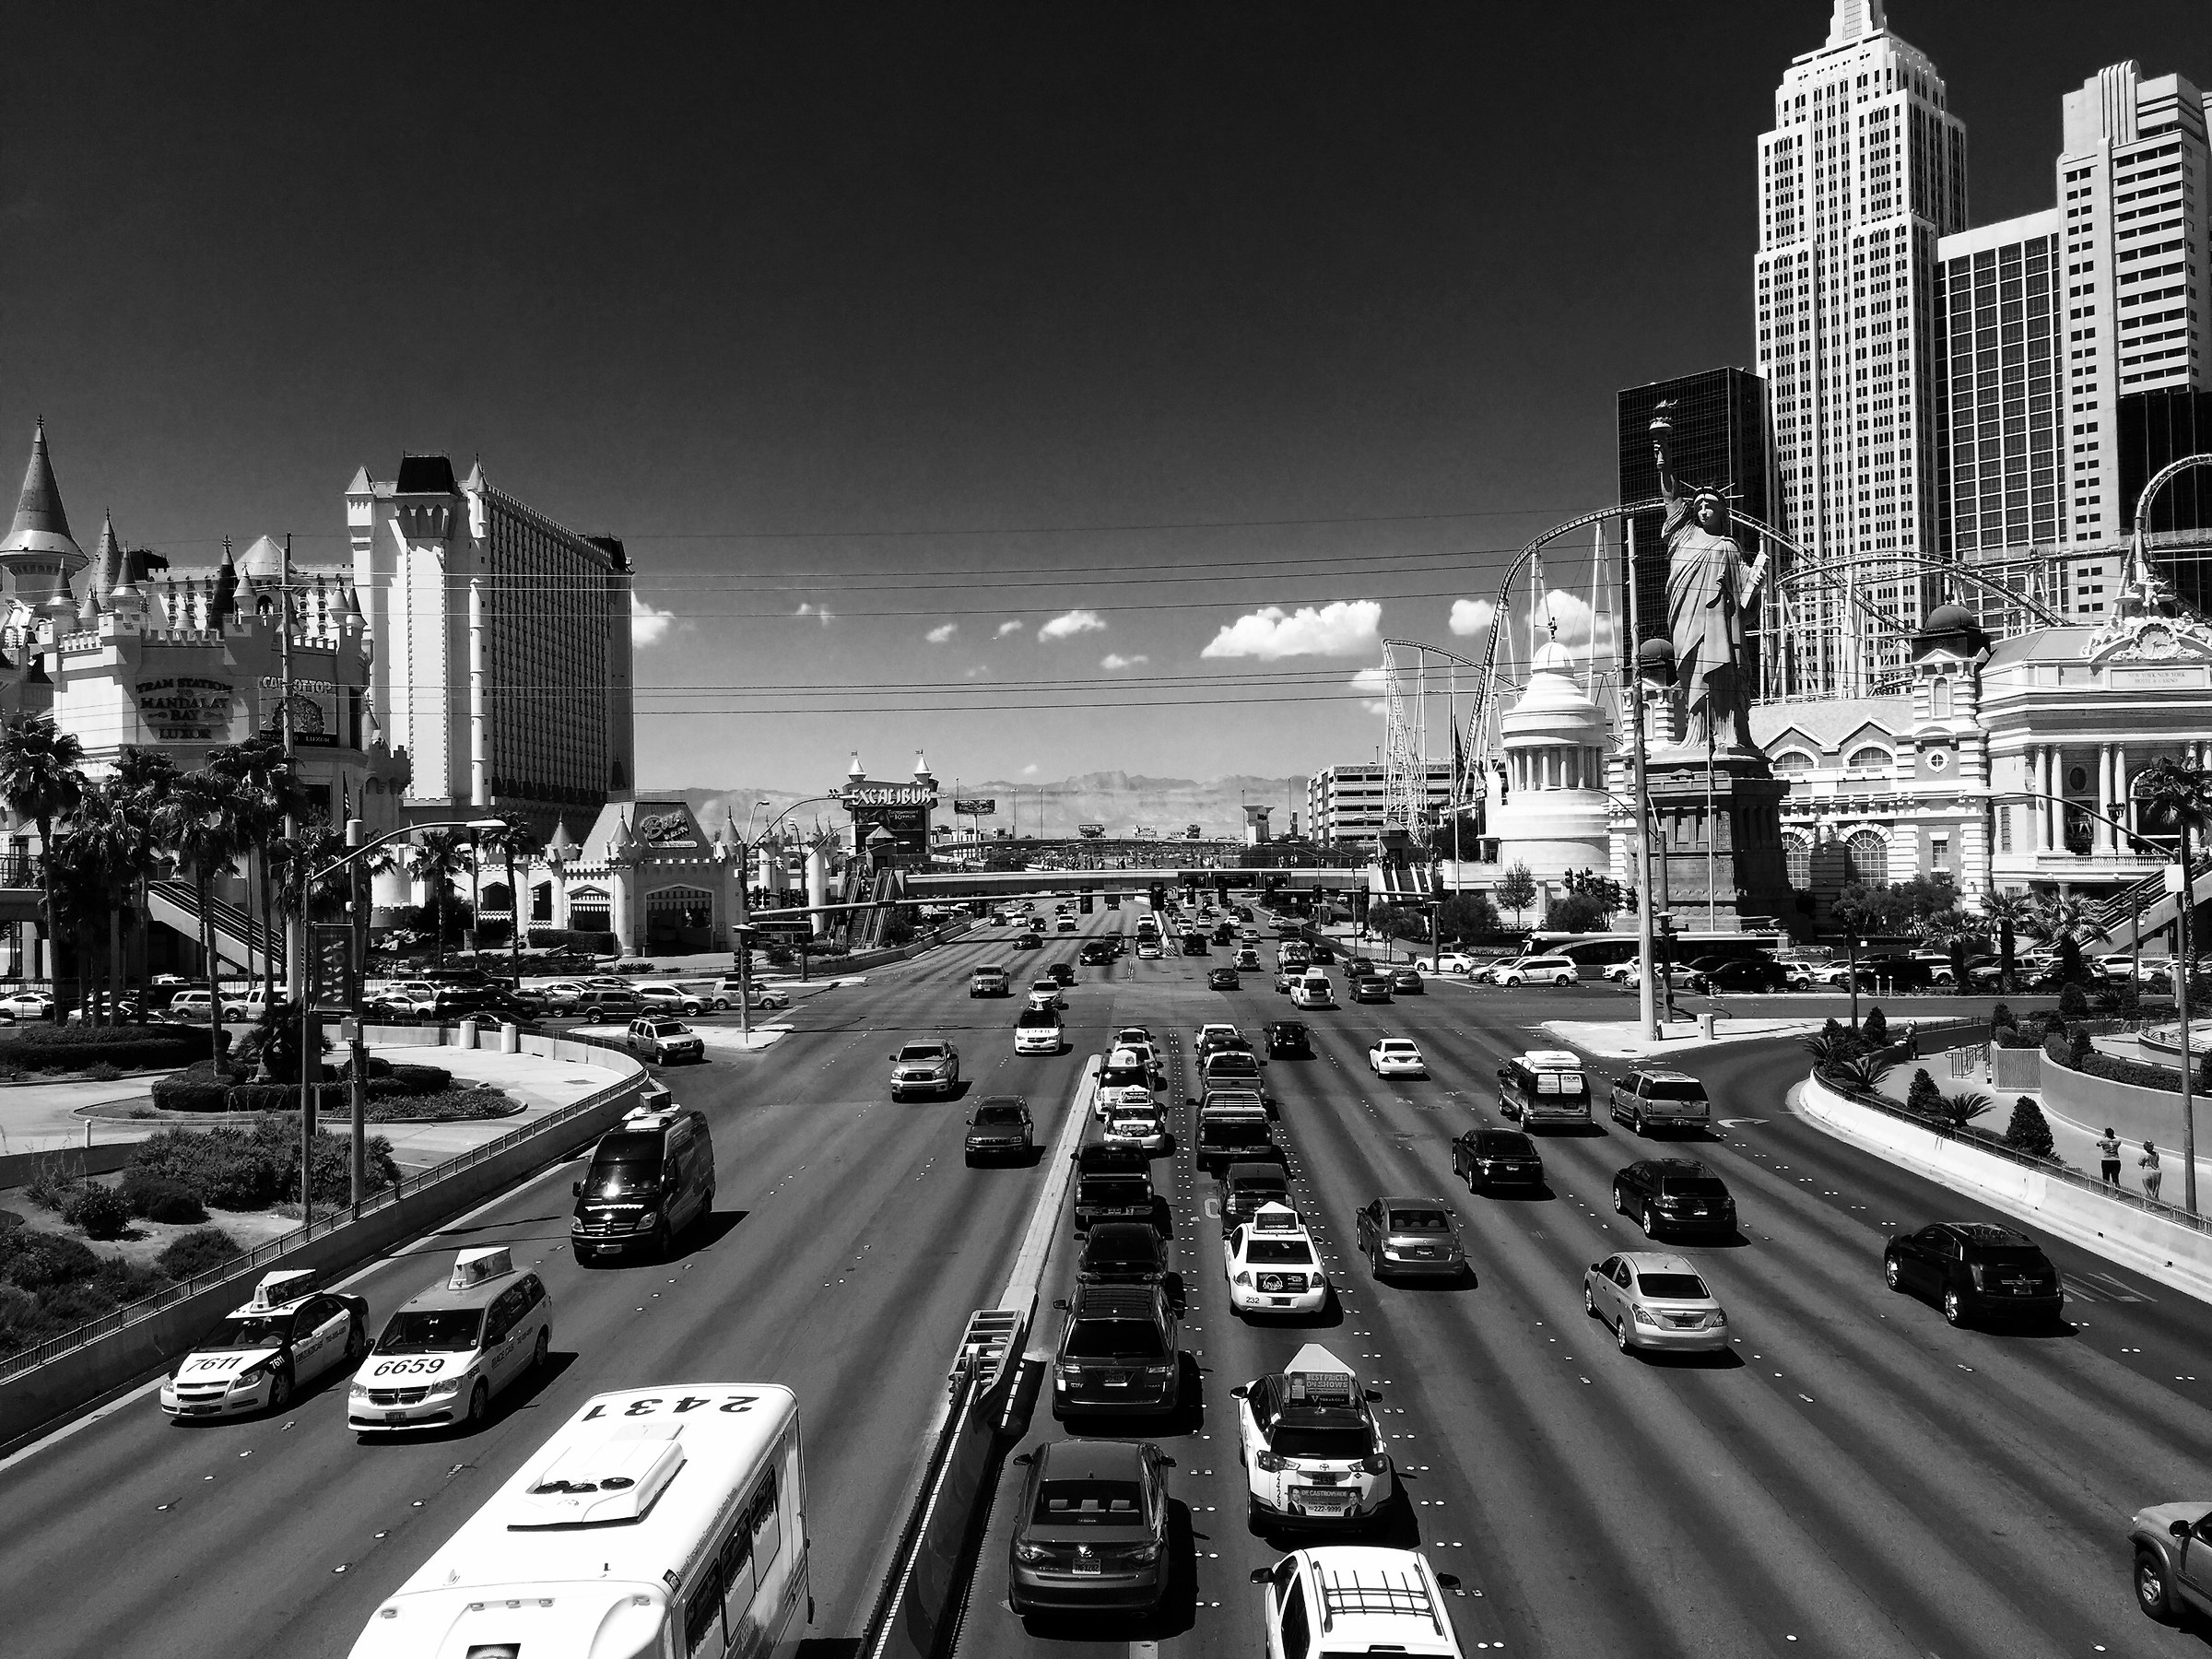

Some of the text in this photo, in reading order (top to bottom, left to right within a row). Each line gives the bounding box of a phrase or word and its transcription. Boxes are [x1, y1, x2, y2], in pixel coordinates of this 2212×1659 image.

[135, 677, 233, 694] TRAM STATION
[139, 697, 229, 710] MANDALAY
[170, 709, 201, 721] BAY
[159, 728, 213, 739] LUXOR
[851, 787, 932, 806] EXCALIBUR
[322, 945, 333, 998] VEGAS
[333, 940, 347, 1003] SEASON
[1245, 1296, 1260, 1304] 232
[185, 1356, 244, 1373] 7611
[268, 1355, 286, 1370] 7611
[373, 1358, 445, 1377] 6659
[1306, 1373, 1348, 1382] BEST PRICES
[582, 1395, 760, 1422] 2431
